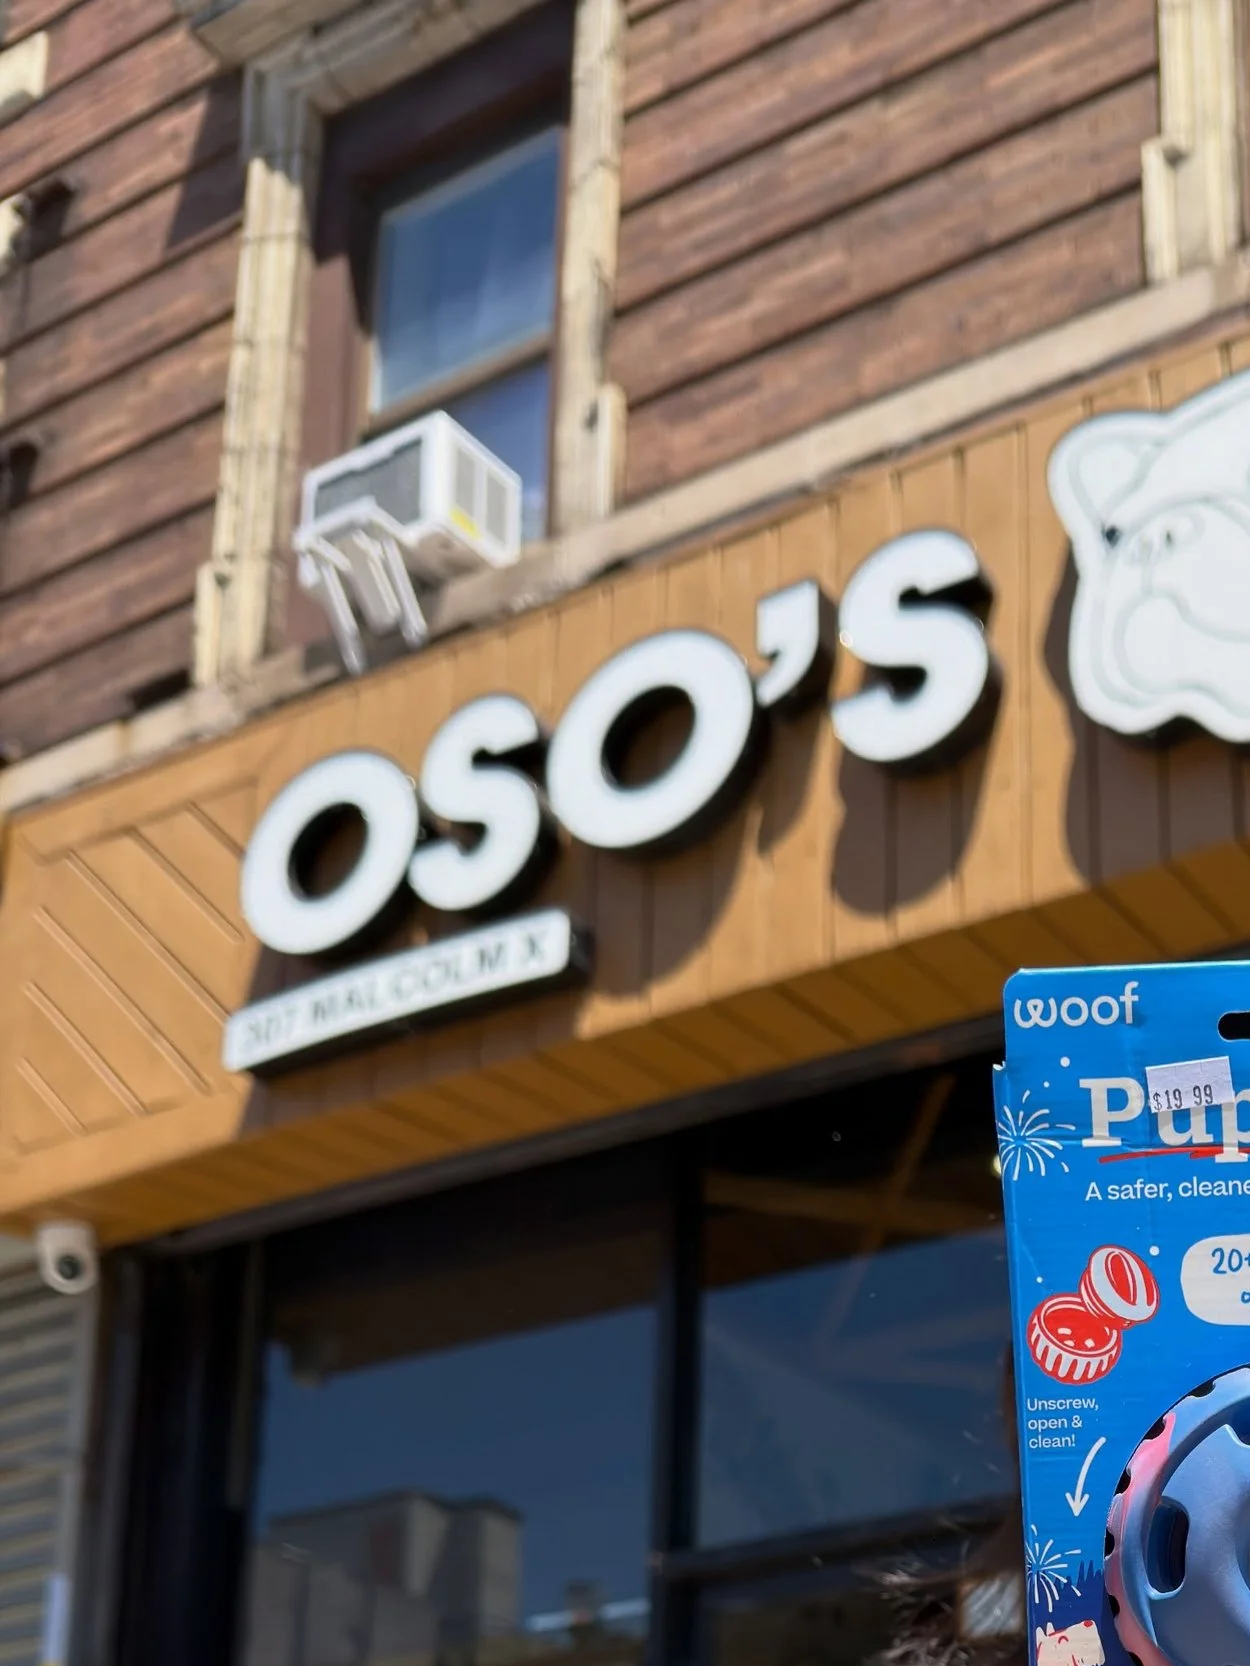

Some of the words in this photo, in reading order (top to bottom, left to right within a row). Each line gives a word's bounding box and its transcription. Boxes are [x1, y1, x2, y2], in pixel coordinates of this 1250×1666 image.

[240, 527, 990, 955] OSO'S
[309, 941, 507, 1024] MALCOLM
[1013, 981, 1139, 1029] woof
[1085, 1182, 1102, 1201] A
[1107, 1176, 1173, 1203] safer,
[1026, 1397, 1100, 1412] Unscrew,
[1027, 1417, 1068, 1433] open
[1071, 1414, 1083, 1429] &
[1028, 1433, 1077, 1449] clean!
